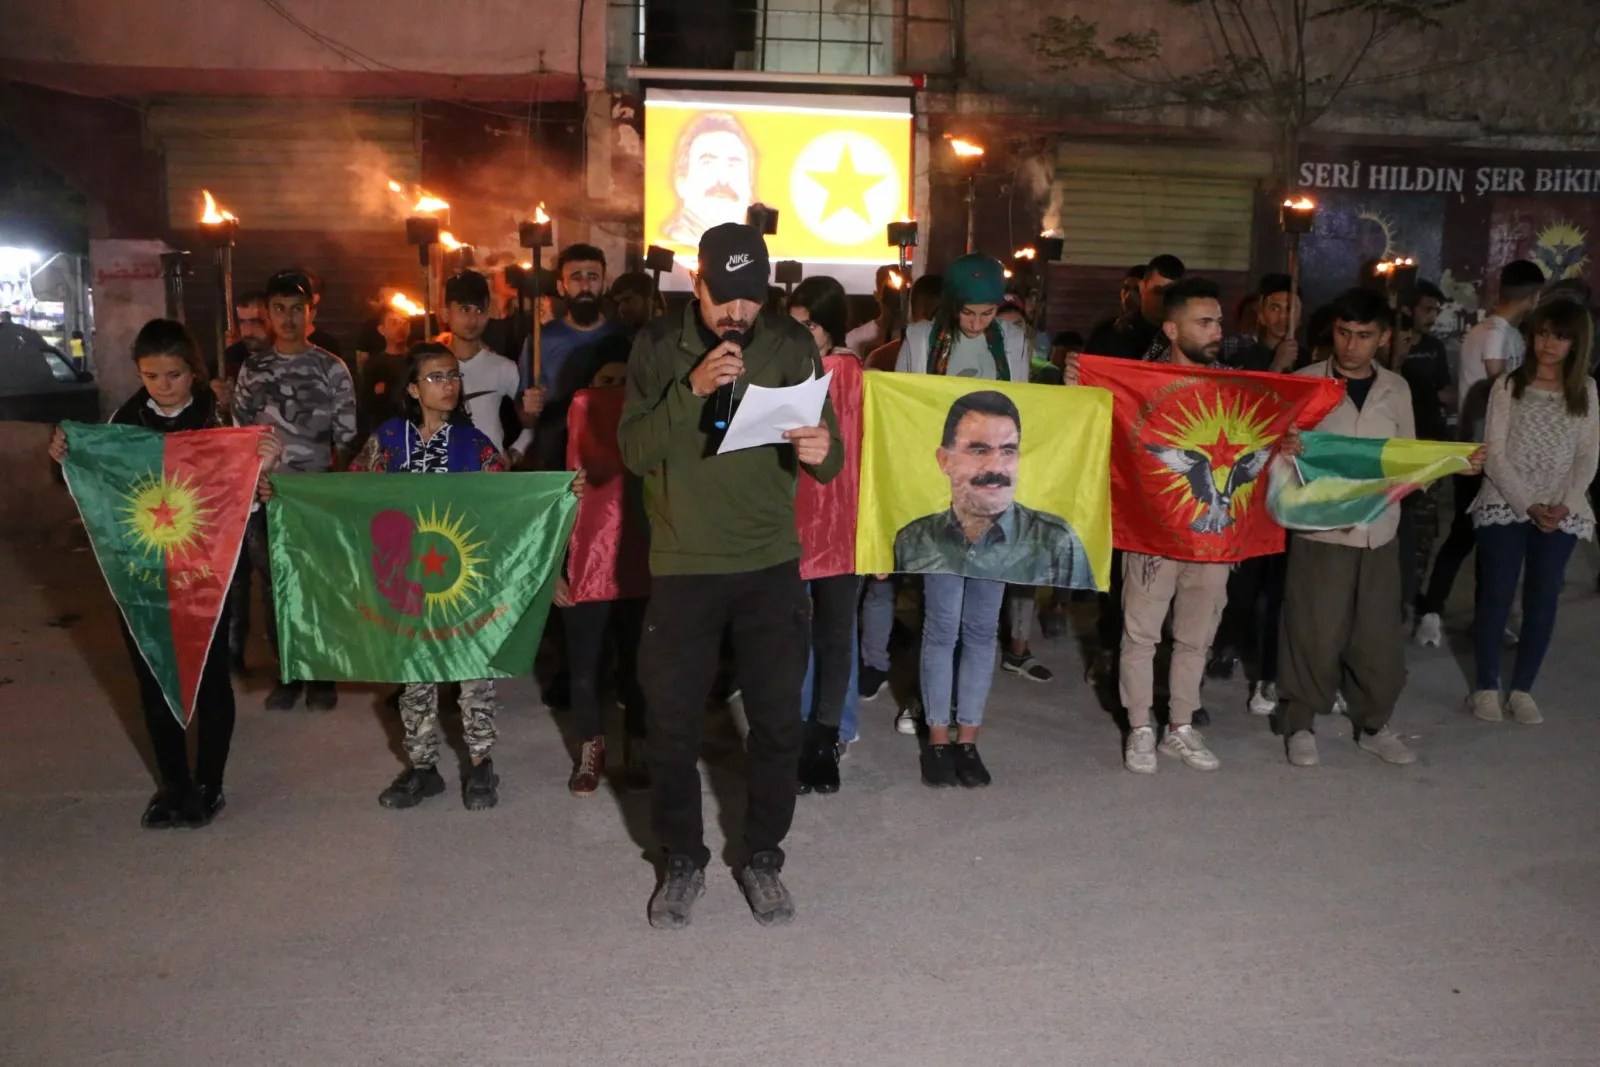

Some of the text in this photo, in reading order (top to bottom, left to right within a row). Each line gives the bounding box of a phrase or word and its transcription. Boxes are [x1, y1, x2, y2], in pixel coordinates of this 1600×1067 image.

[1298, 160, 1361, 188] SERÎ
[1368, 165, 1465, 192] HILDIN
[1475, 167, 1526, 196] ŞER
[729, 254, 749, 264] NIKE
